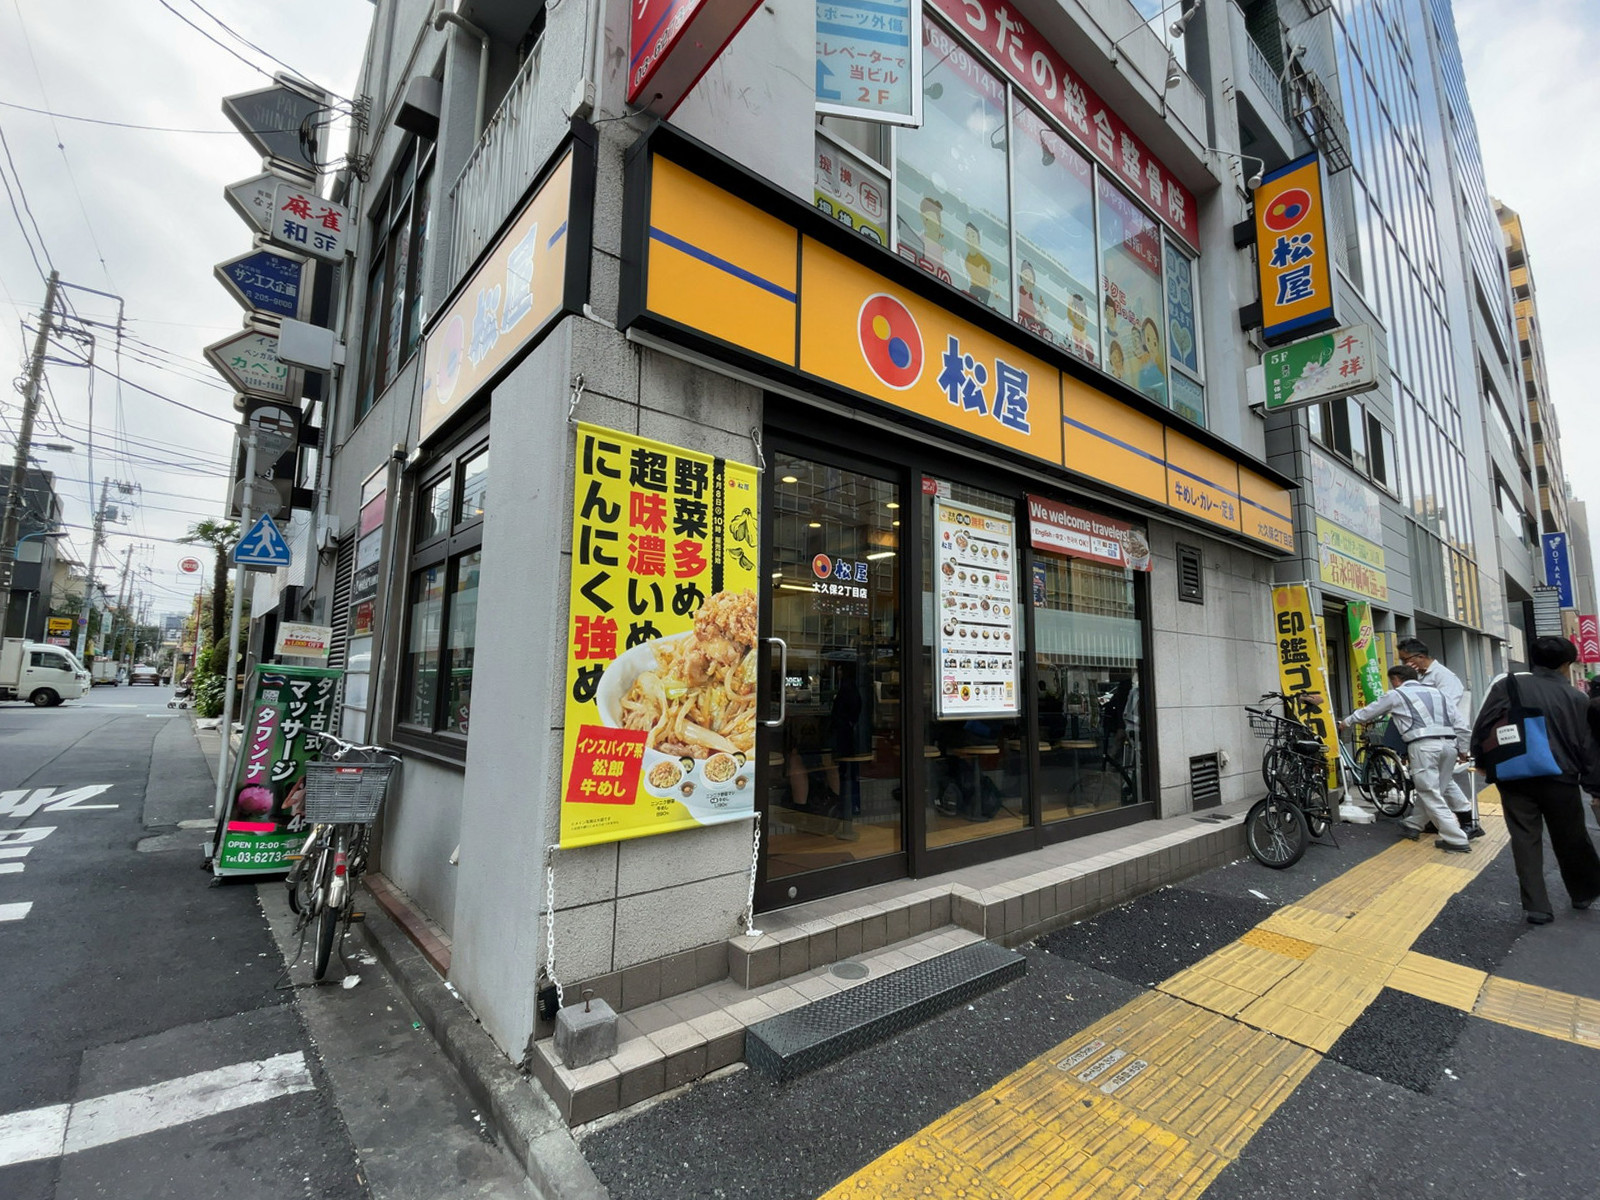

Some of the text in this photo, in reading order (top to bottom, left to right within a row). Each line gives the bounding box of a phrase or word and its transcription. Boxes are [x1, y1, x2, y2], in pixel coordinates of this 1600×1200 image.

[849, 64, 899, 84] 当ビル
[281, 194, 344, 233] 麻雀
[283, 219, 337, 252] 和 3F
[234, 267, 297, 298] サンエス企画
[1268, 231, 1317, 307] 松屋
[468, 222, 539, 368] 松屋
[1270, 351, 1289, 365] 5F
[936, 333, 1031, 436] 松屋
[1029, 501, 1130, 542] We welcome travelers!
[572, 434, 623, 705] にんにく強め
[834, 558, 869, 583] 松屋
[812, 581, 869, 600] 大久保2丁目店
[271, 679, 312, 782] マッサージ
[303, 677, 334, 751] タイ古式
[246, 707, 276, 780] タワンナ
[577, 737, 645, 759] インスパイア系
[591, 759, 625, 777] 松郎
[580, 778, 626, 798] 牛めし
[227, 840, 252, 849] OPEN
